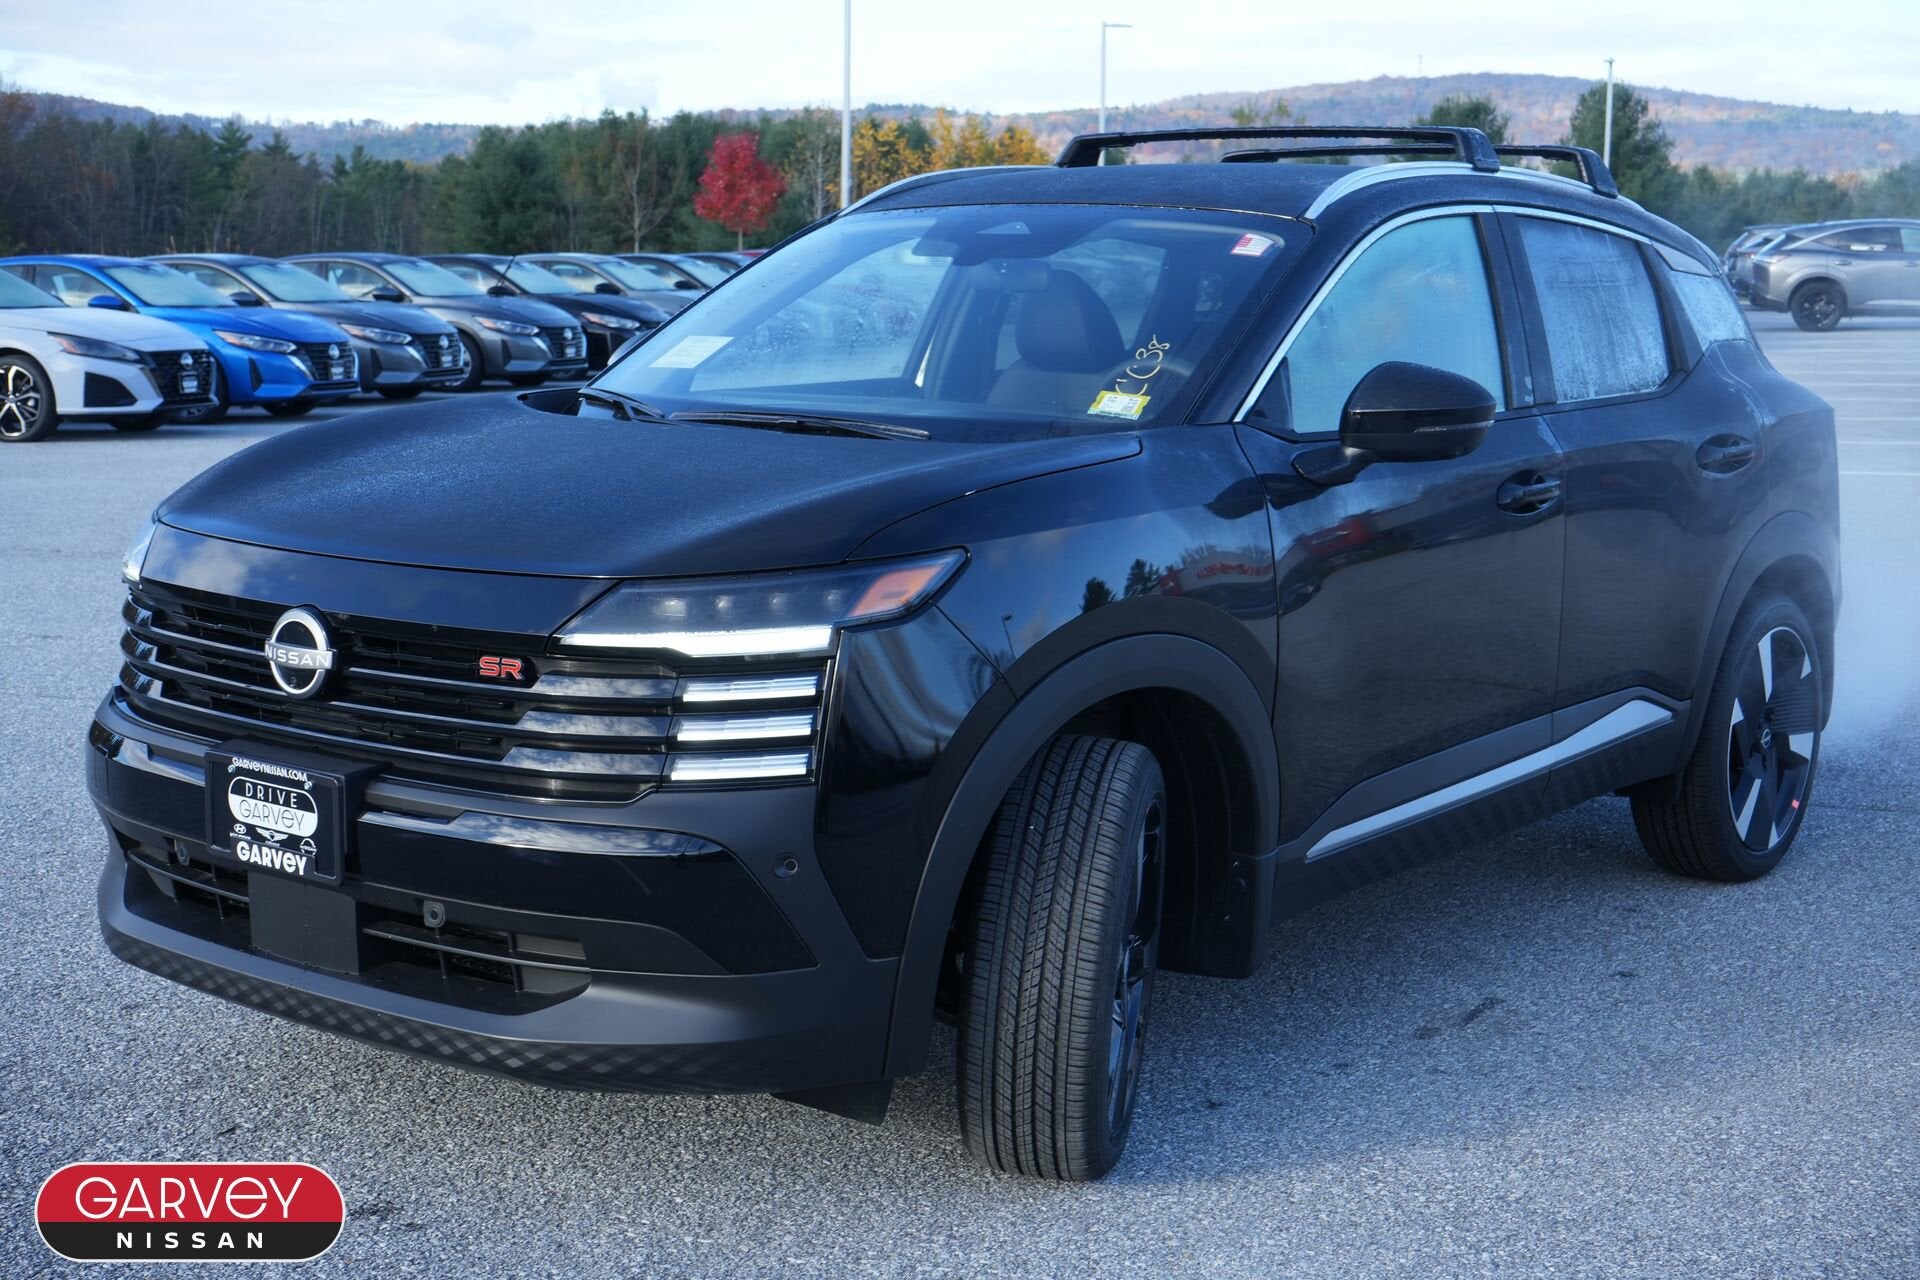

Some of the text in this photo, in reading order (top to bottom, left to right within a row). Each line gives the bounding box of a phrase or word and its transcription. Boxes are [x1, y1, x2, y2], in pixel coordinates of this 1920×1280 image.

[265, 643, 331, 668] NISSAN
[479, 656, 523, 680] SR
[245, 782, 298, 808] DRIVE
